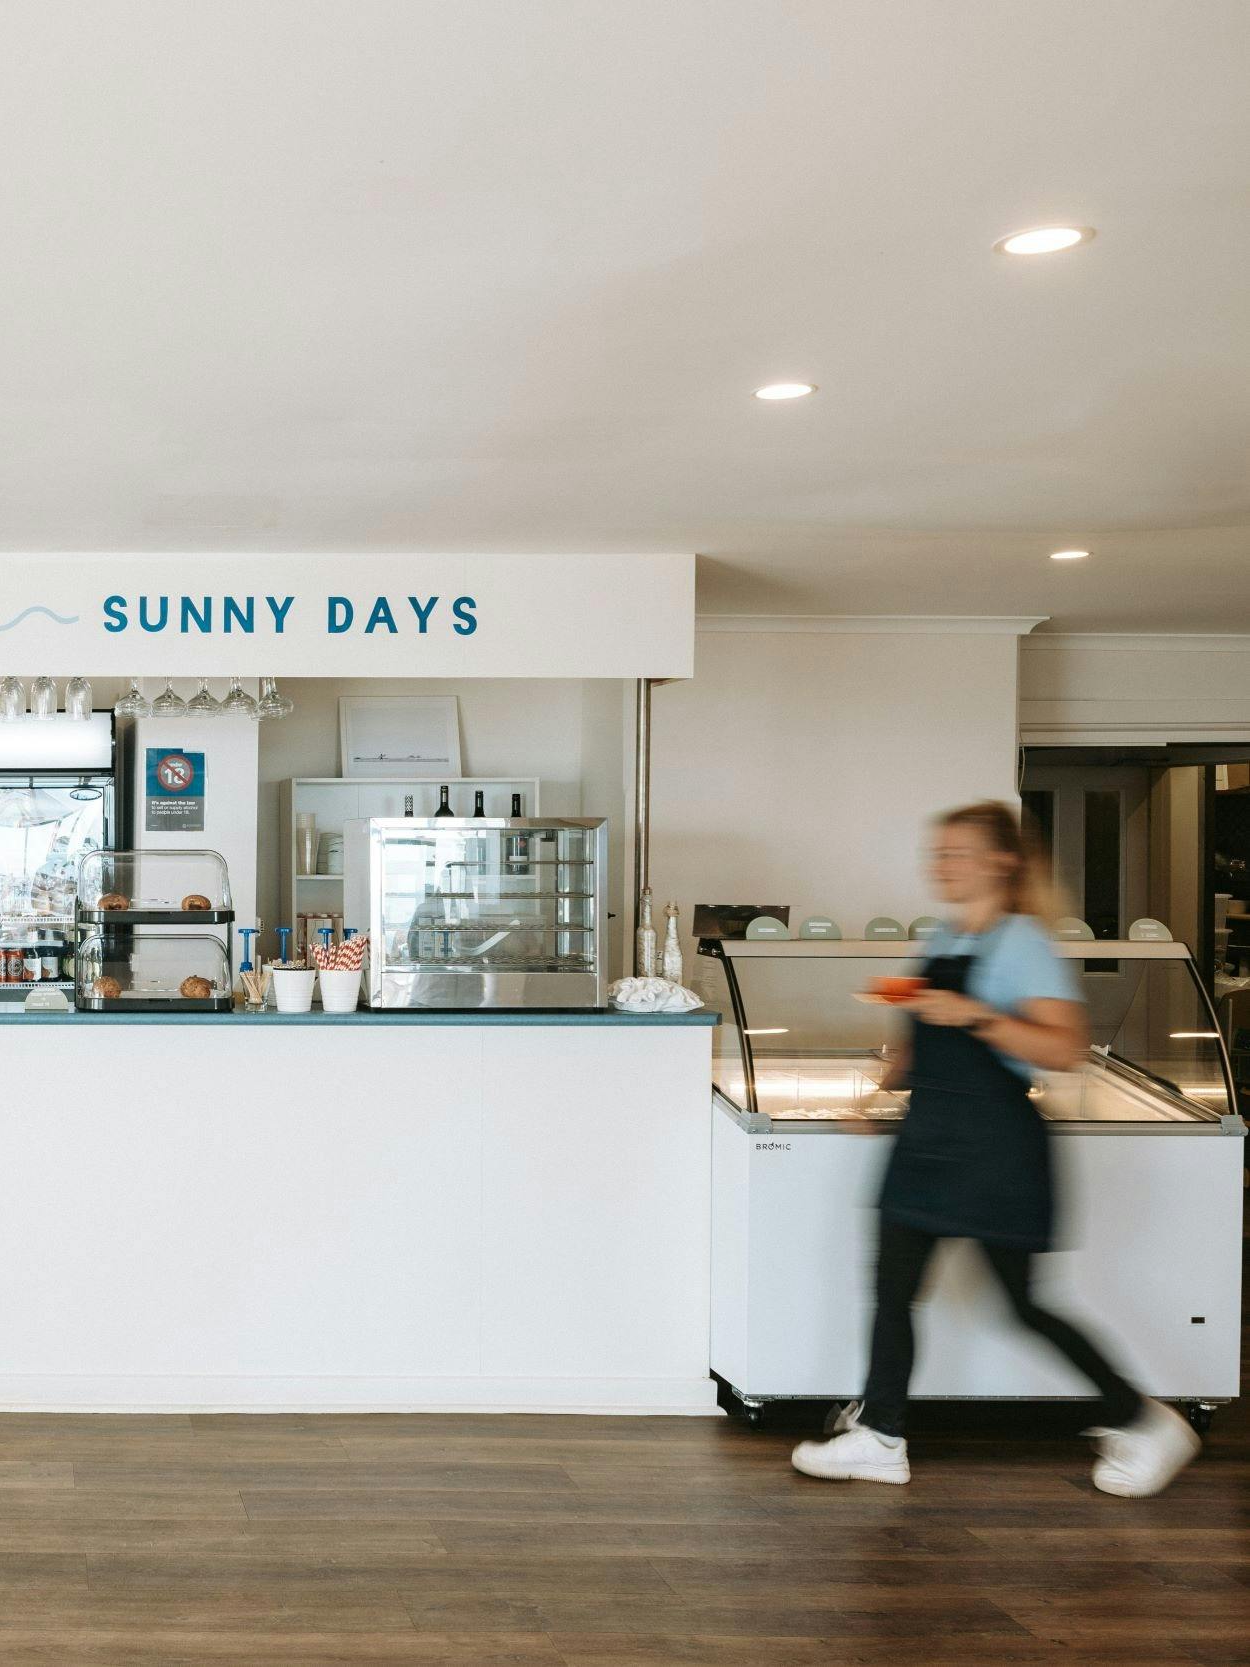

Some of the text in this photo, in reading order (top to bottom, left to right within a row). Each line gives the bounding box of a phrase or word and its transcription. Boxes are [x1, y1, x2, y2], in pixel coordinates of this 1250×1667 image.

[103, 593, 478, 637] SUNNY DAYS
[164, 767, 186, 784] 18
[755, 1142, 792, 1151] BROMIC
